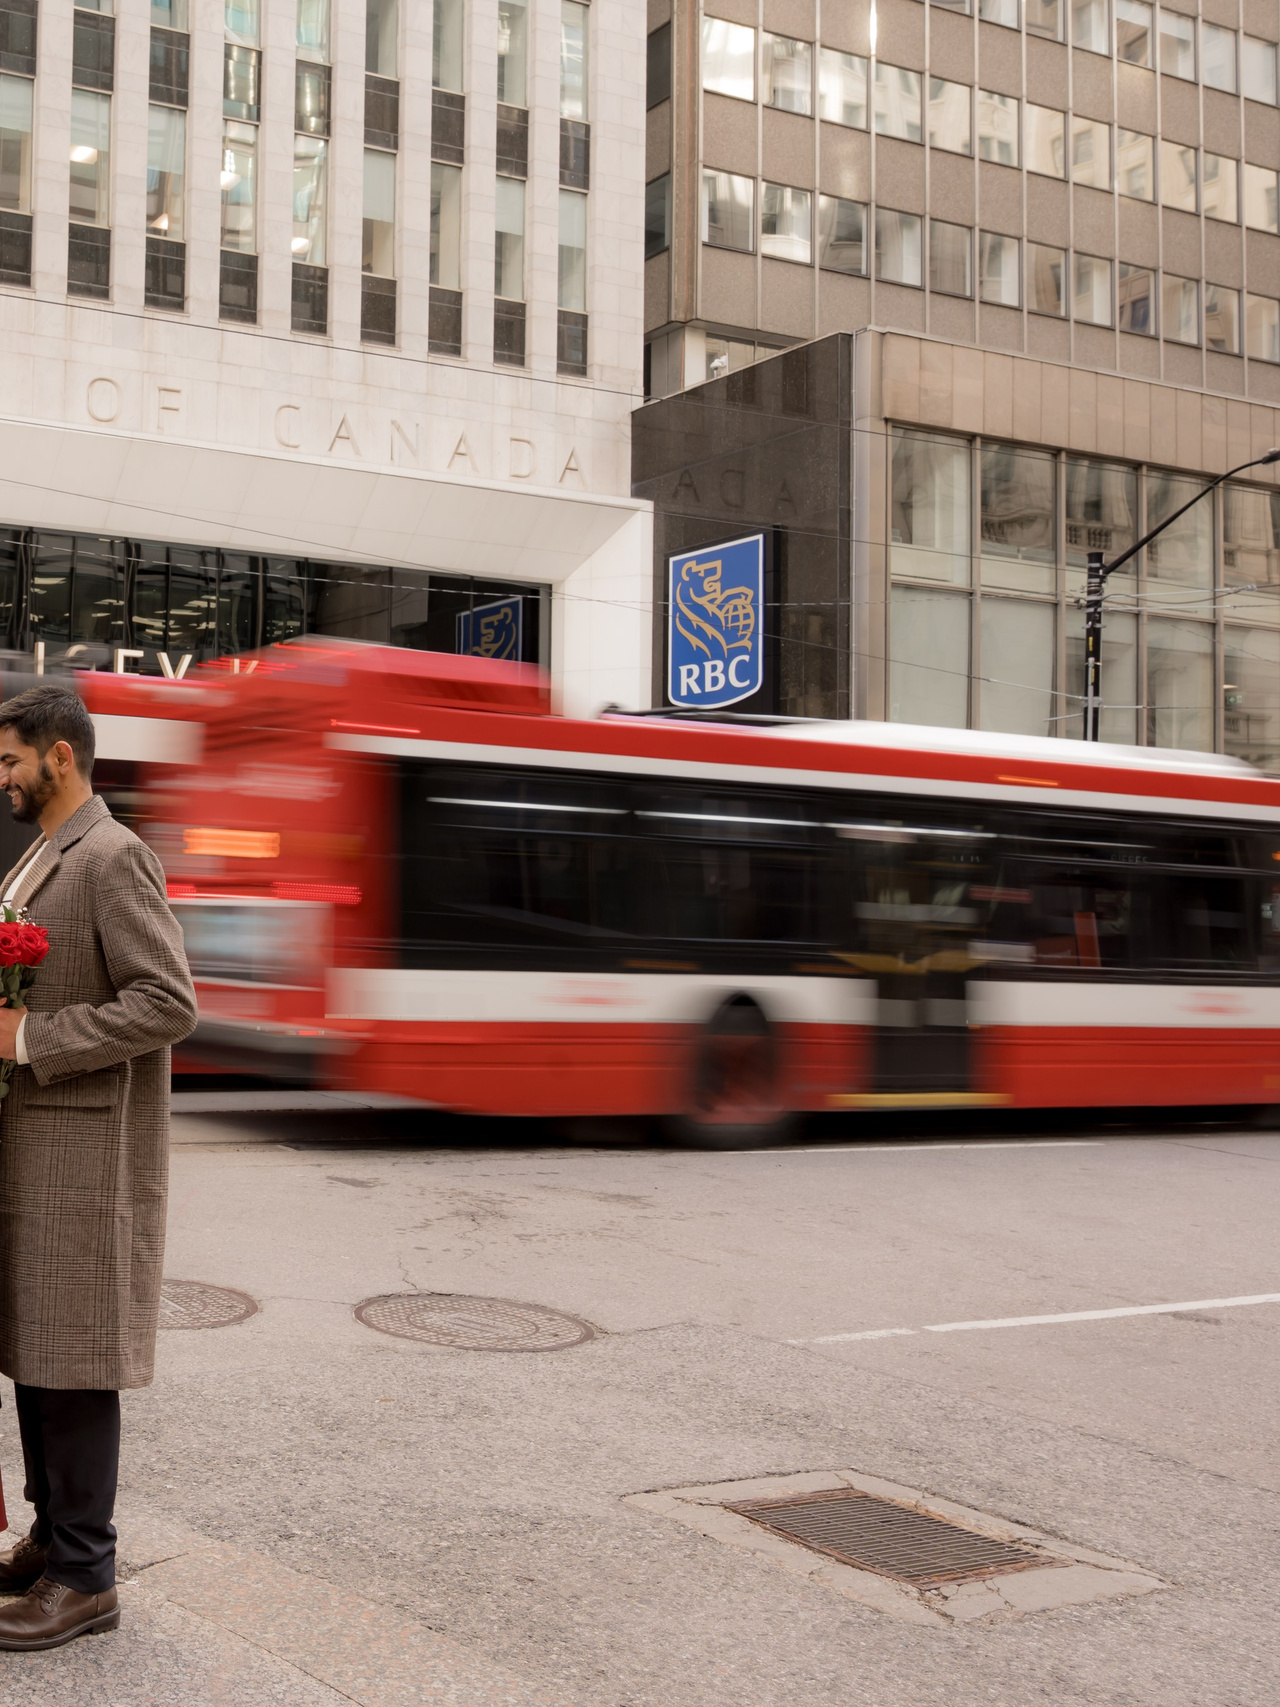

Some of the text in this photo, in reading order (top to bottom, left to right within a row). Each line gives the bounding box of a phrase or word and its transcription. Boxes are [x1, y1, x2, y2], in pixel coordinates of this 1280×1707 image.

[85, 376, 183, 432] OF
[273, 403, 588, 486] CANADA
[678, 654, 751, 697] RBC
